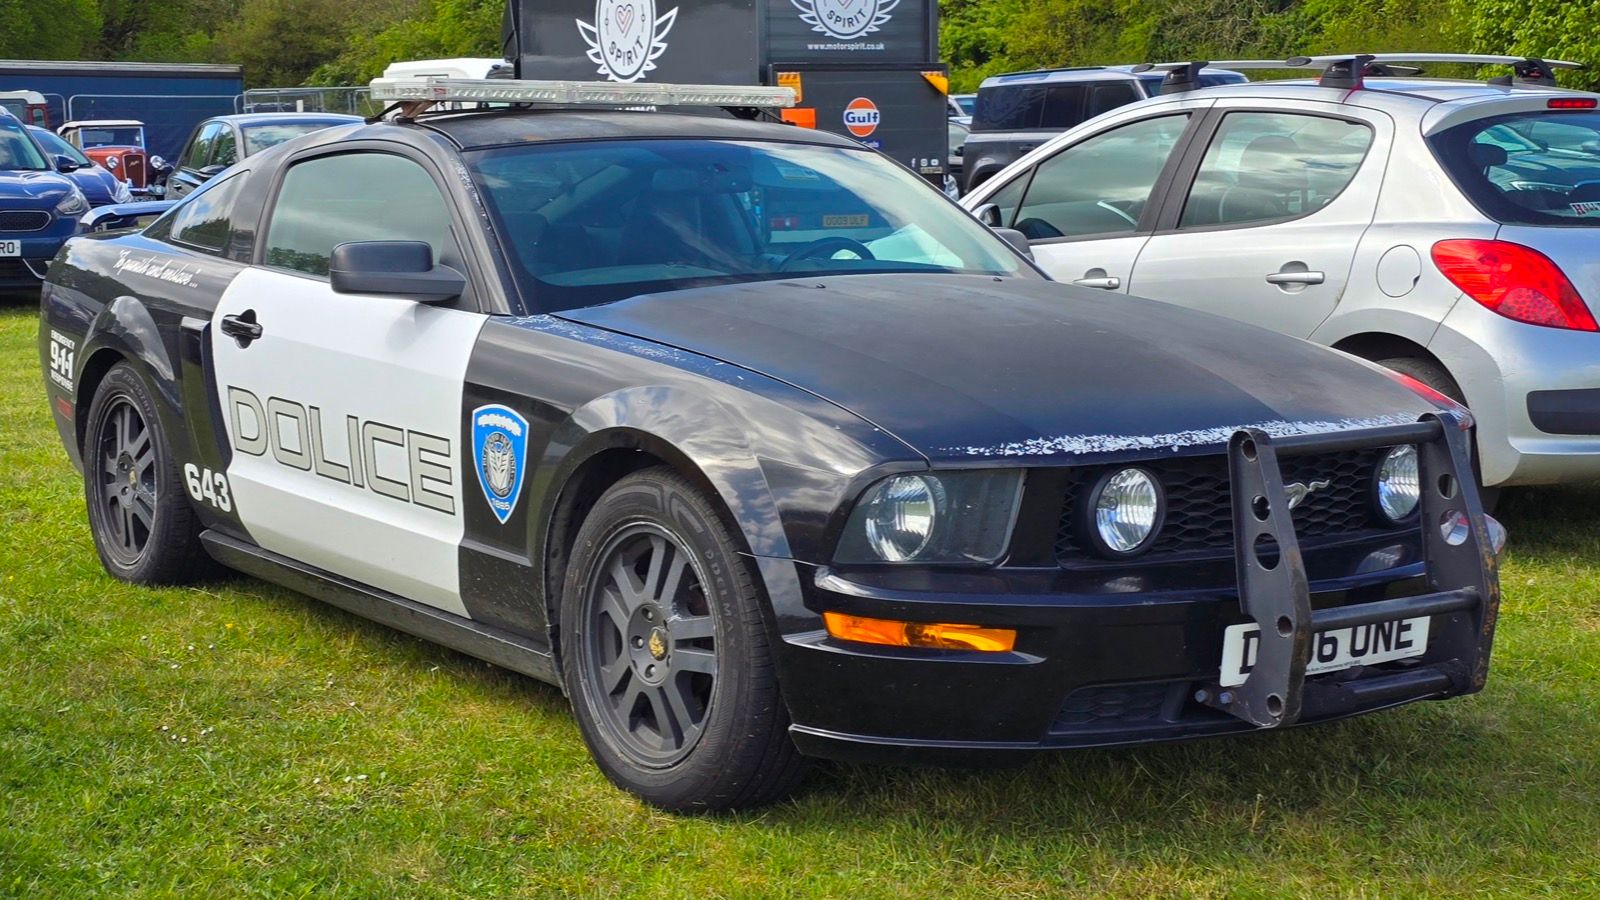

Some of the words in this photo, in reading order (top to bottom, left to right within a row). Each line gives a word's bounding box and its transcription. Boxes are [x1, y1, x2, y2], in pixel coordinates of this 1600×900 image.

[824, 8, 867, 28] SPIRIT
[608, 35, 644, 66] SPIRIT
[807, 42, 885, 51] www.motorspirit.co.uk
[845, 111, 879, 123] Gulf
[183, 462, 232, 513] 643
[1350, 620, 1414, 658] UNE
